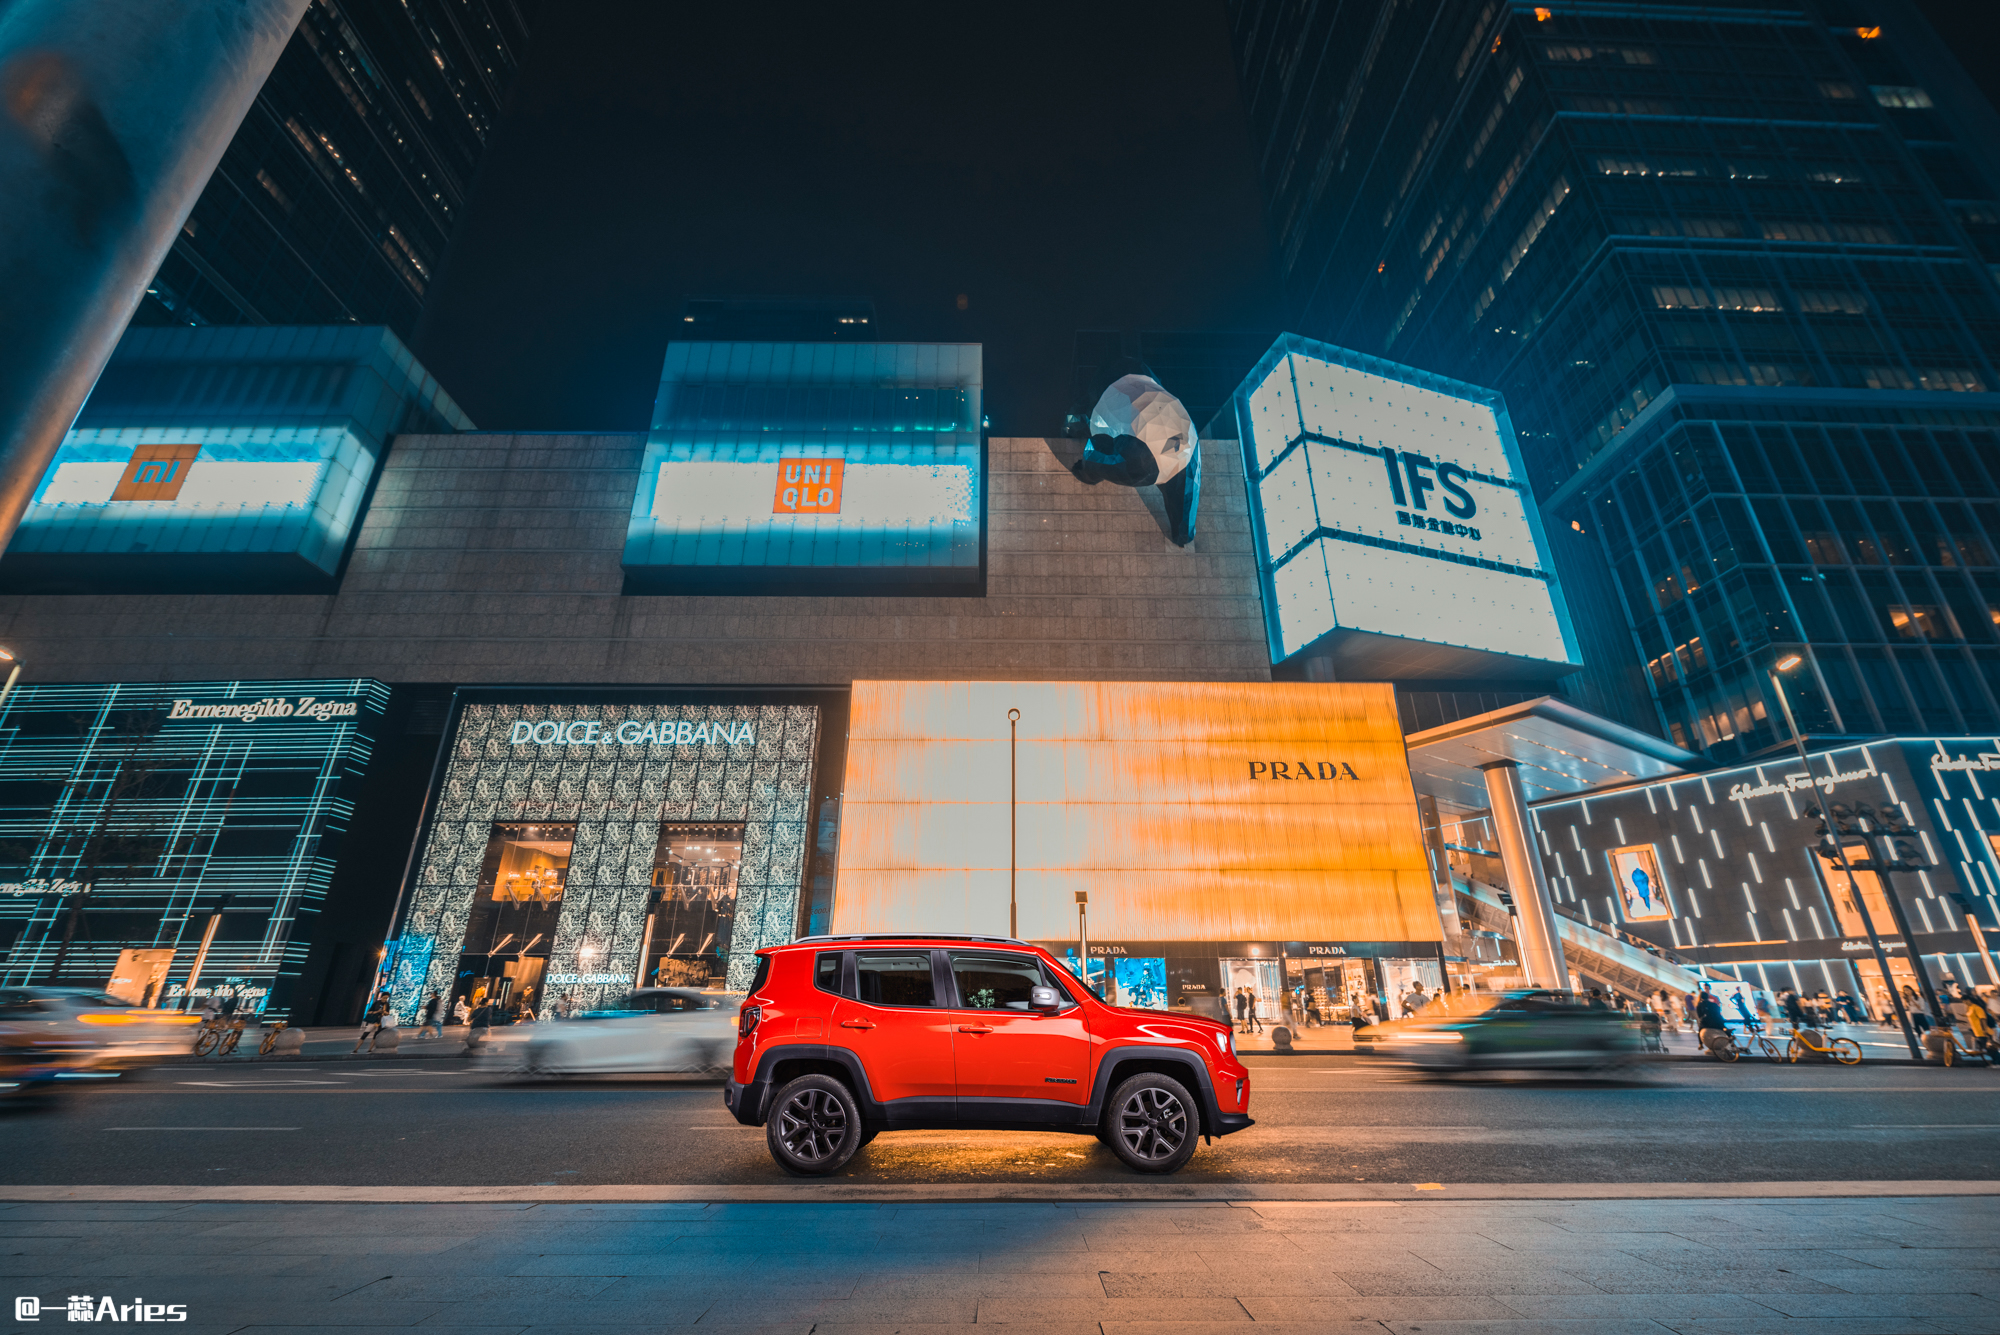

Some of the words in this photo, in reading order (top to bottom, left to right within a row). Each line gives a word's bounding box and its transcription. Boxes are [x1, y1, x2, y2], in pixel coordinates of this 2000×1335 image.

[785, 465, 832, 484] UNI
[1381, 446, 1477, 520] IFS
[782, 487, 834, 510] QLO
[166, 697, 294, 722] Ermenegildo
[293, 696, 358, 722] Zegna
[511, 720, 600, 744] DOLCE
[616, 720, 756, 745] GABBANA
[1248, 761, 1360, 780] PRADA
[1090, 946, 1128, 955] PRADA
[1309, 946, 1347, 955] PRADA
[582, 973, 631, 984] GABBANA
